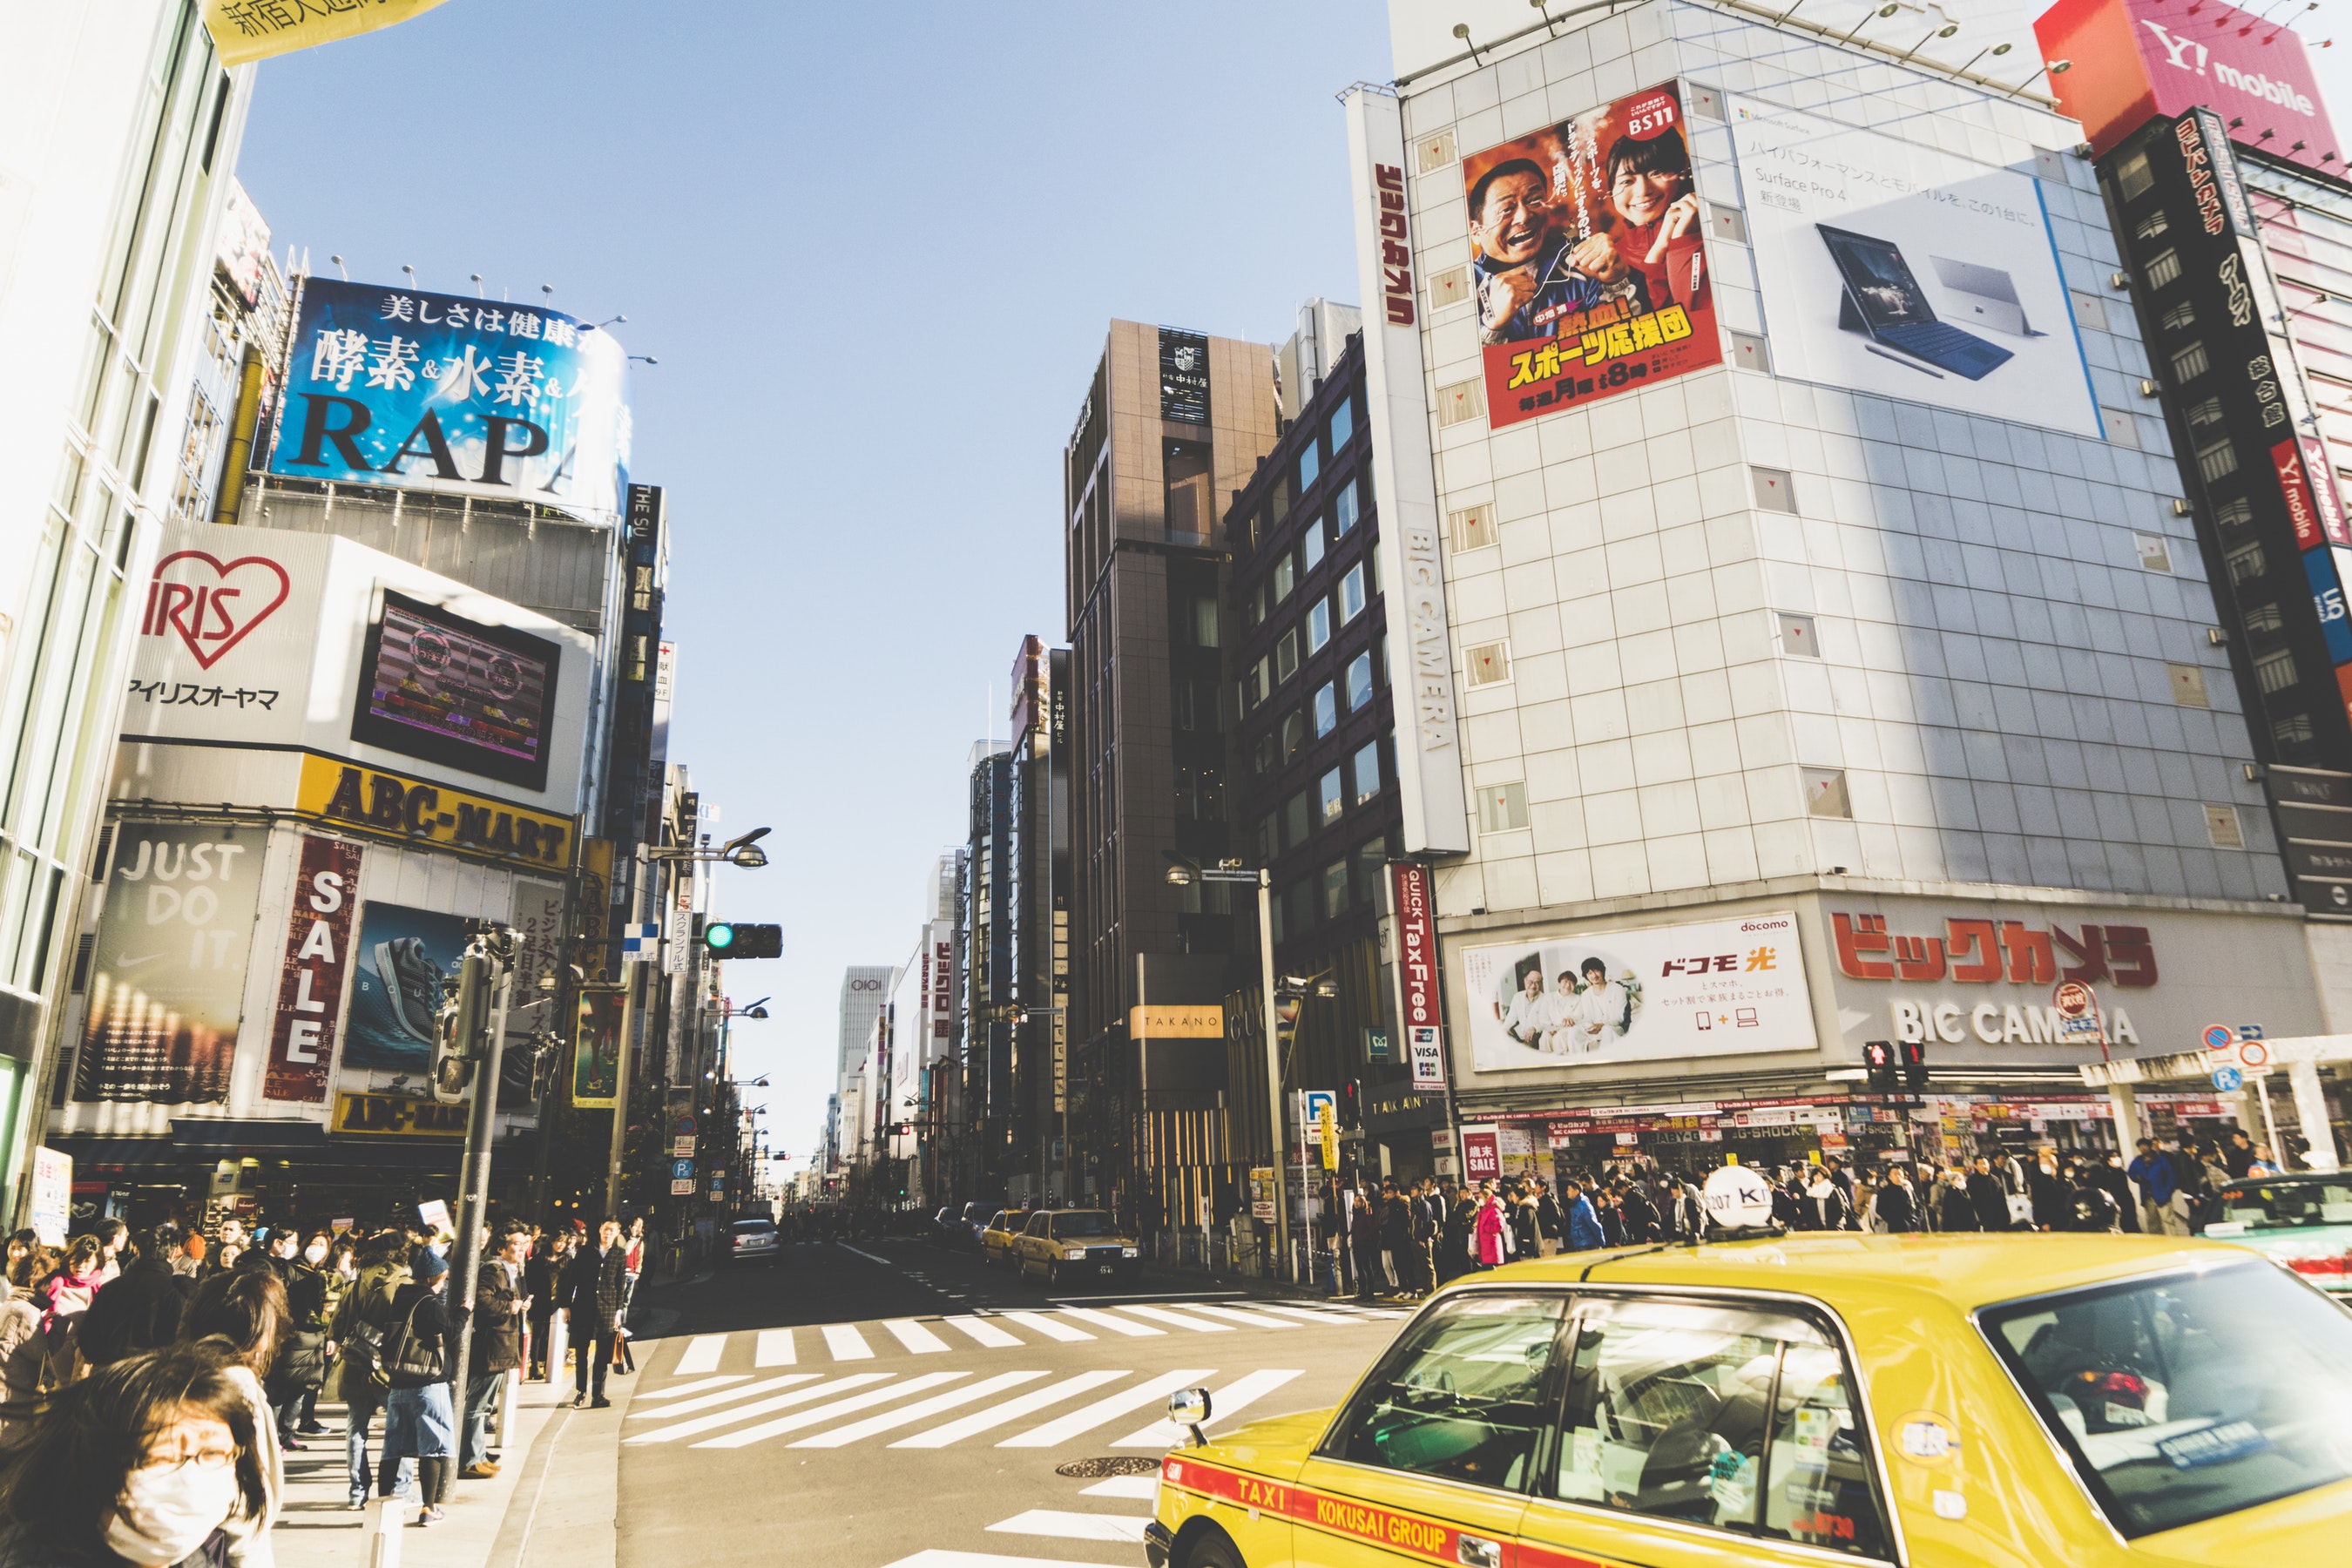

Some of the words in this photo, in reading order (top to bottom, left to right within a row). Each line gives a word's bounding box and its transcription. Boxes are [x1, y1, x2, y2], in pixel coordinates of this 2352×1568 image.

[2141, 19, 2208, 77] Y!
[2213, 62, 2316, 118] mobile
[1751, 112, 1783, 131] Microsoft
[1585, 138, 1603, 190] スポーツを
[1755, 167, 1808, 193] Surface
[1810, 178, 1829, 199] Pro
[1835, 189, 1847, 202] 4
[2176, 117, 2225, 236] ヨドバシカメラ
[1759, 189, 1802, 212] 新登場
[1375, 163, 1416, 328] ビックカメラ
[1507, 301, 1693, 390] スポーツ応援団
[2277, 452, 2301, 485] Y!
[635, 484, 652, 514] THE
[2285, 487, 2311, 541] mobile
[2314, 476, 2342, 540] mobile
[1406, 528, 1437, 588] BIC
[2322, 587, 2345, 621] UQ
[657, 661, 670, 686] 献血
[1413, 596, 1452, 752] CAMERA
[324, 766, 566, 865] ABC-MART
[118, 839, 246, 882] JUST
[334, 841, 359, 854] SALE
[145, 885, 219, 927] DO
[1408, 869, 1424, 920] QUICK
[672, 913, 687, 971] スクランブル式
[1740, 919, 1789, 933] docomo
[286, 870, 343, 1064] SALE
[624, 951, 655, 961] 時差式
[1661, 945, 1778, 978] ドコモ光
[1830, 911, 2159, 987] ビックカメラ
[934, 942, 950, 1012] ビックロ
[1661, 990, 1792, 1008] セット割で家族まるごとお得。
[1145, 1016, 1218, 1027] TAKANO
[1890, 1001, 1968, 1044] BIC
[1414, 1046, 1440, 1058] VISA
[1469, 1146, 1494, 1159] 歳末
[1737, 1124, 1801, 1139] G-SHOCK
[1469, 1157, 1496, 1173] SALE
[1237, 1477, 1285, 1511] TAXI
[1316, 1497, 1384, 1539] KOKUSAI
[1387, 1511, 1447, 1555] GROUP
